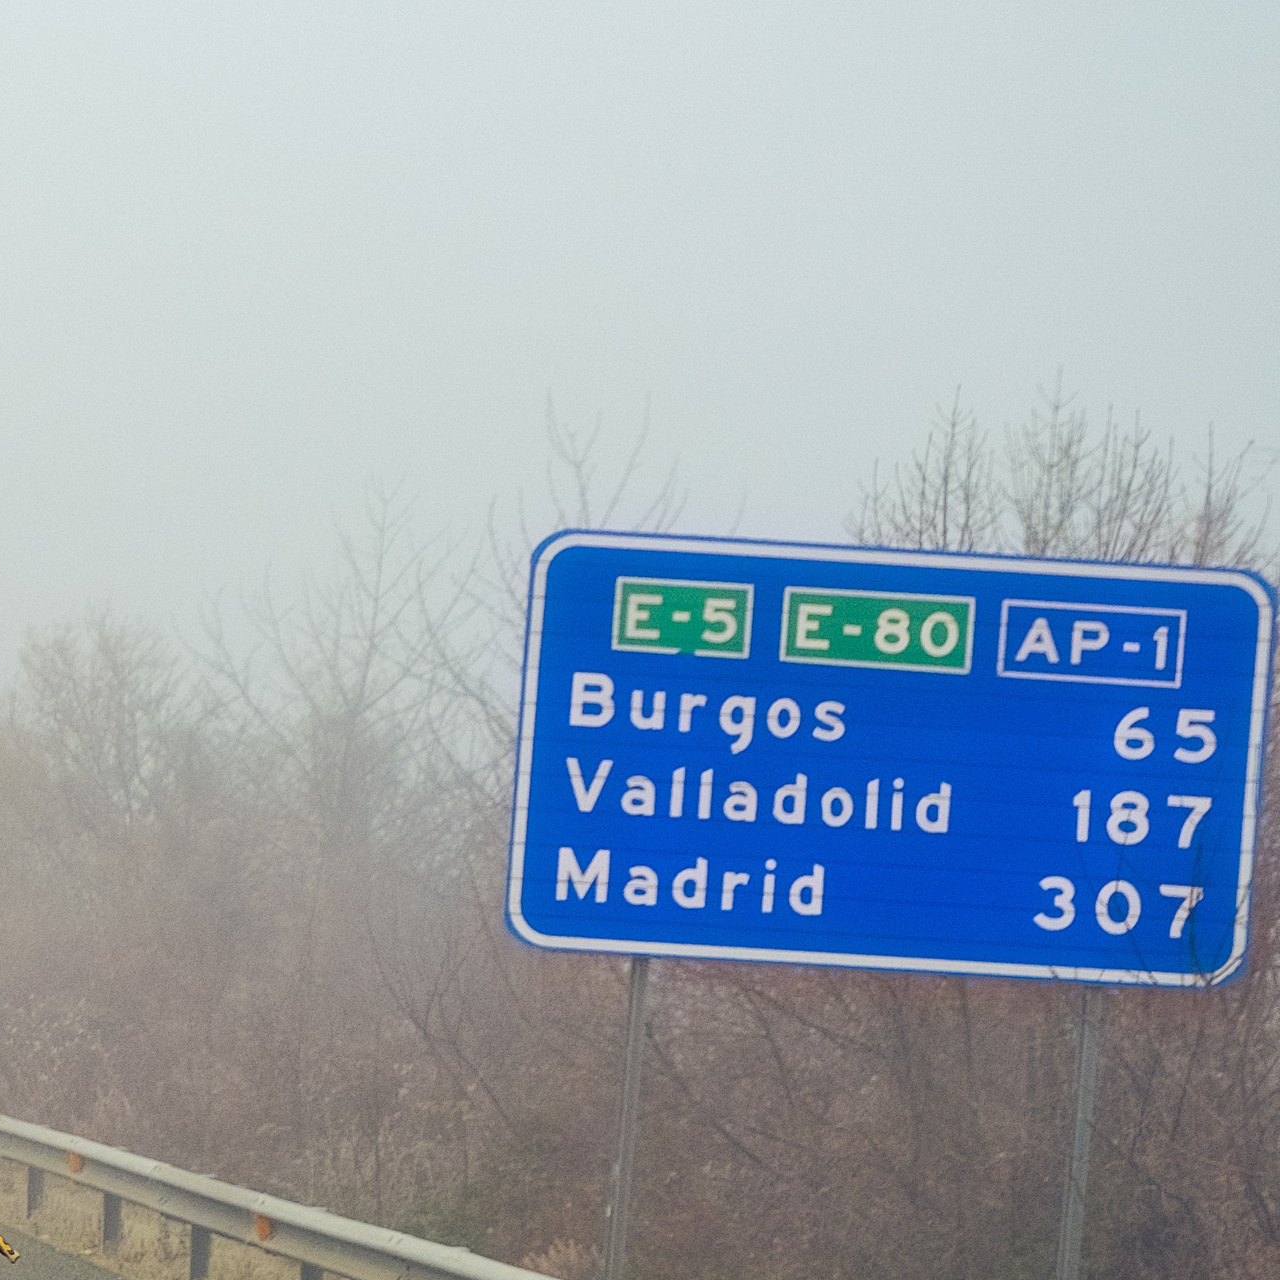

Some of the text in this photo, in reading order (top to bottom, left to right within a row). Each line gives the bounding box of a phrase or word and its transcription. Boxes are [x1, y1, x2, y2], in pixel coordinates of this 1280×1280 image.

[625, 593, 738, 644] E-5
[795, 603, 960, 658] E-80
[1015, 617, 1169, 670] AP-1
[569, 671, 1217, 764] Burgos 65
[566, 757, 1212, 849] Valladolid 187
[555, 847, 1205, 939] Madrid 307
